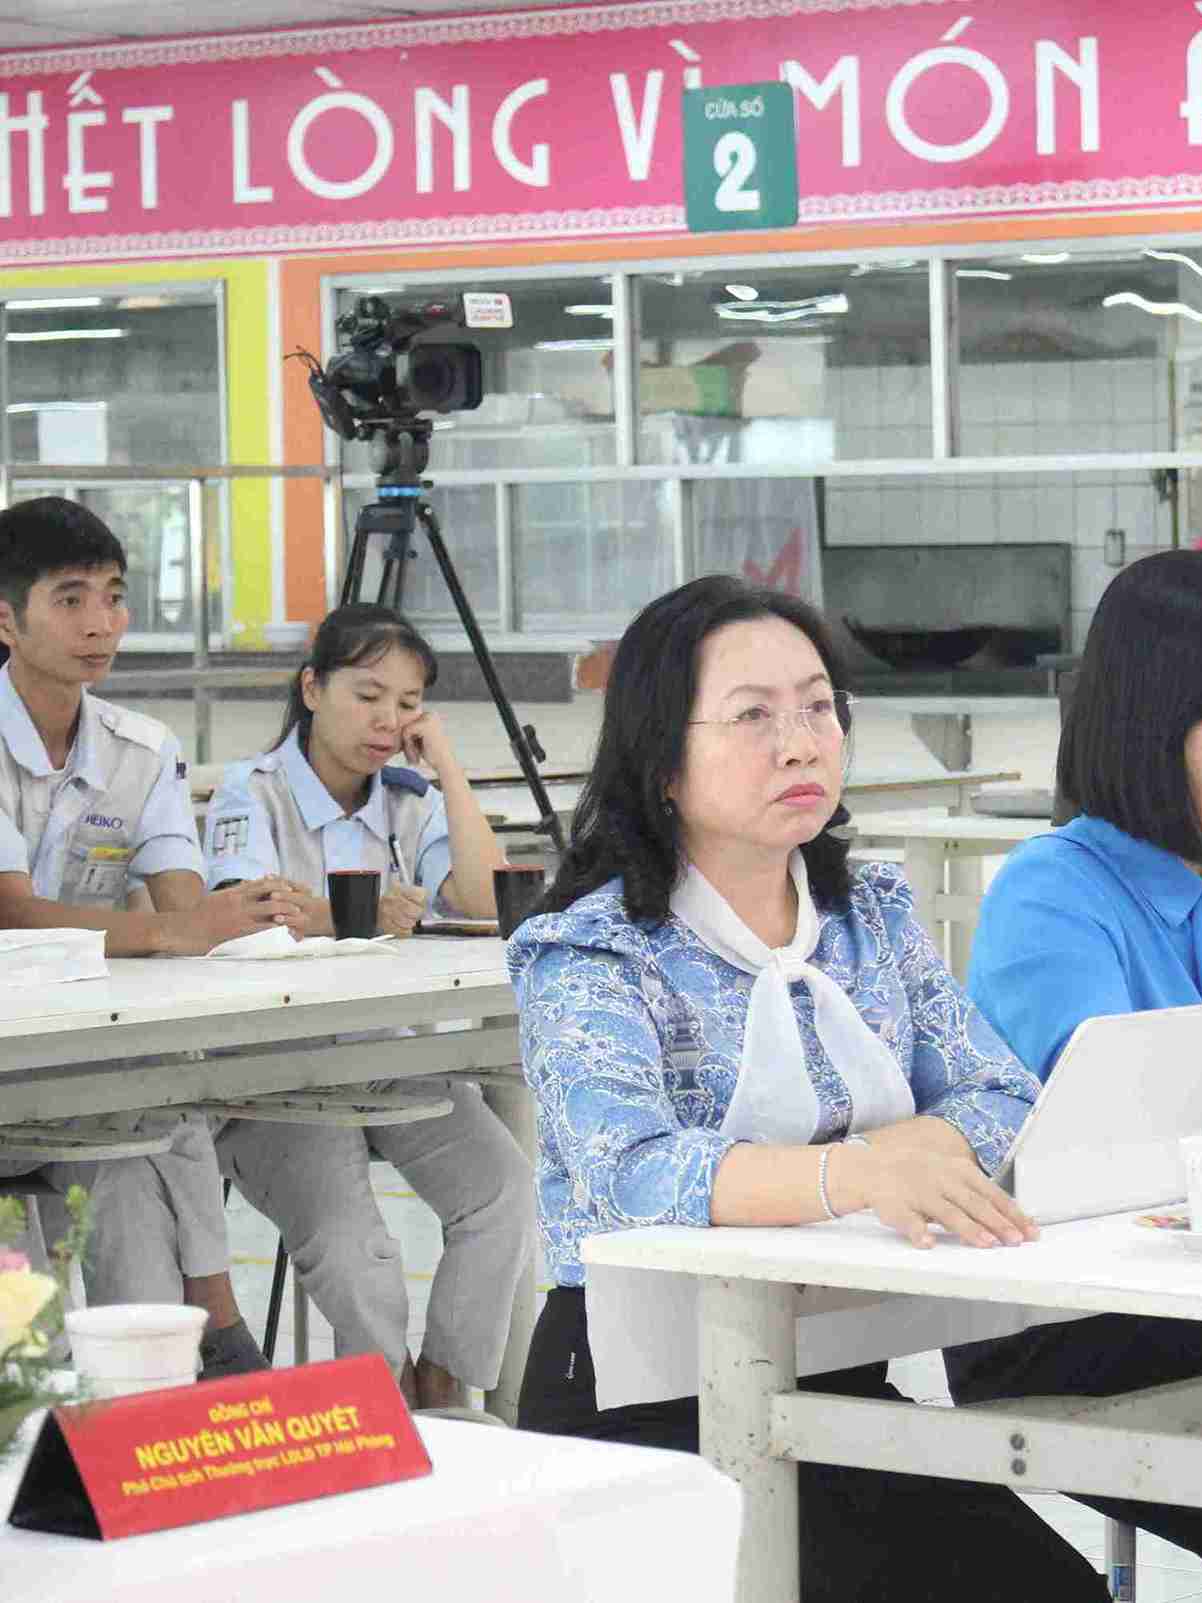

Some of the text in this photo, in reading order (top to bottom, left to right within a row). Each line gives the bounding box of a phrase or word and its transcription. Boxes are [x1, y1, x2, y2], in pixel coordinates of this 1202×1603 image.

[231, 66, 550, 205] LÒNG
[779, 16, 1100, 168] MÓN
[713, 131, 760, 212] 2
